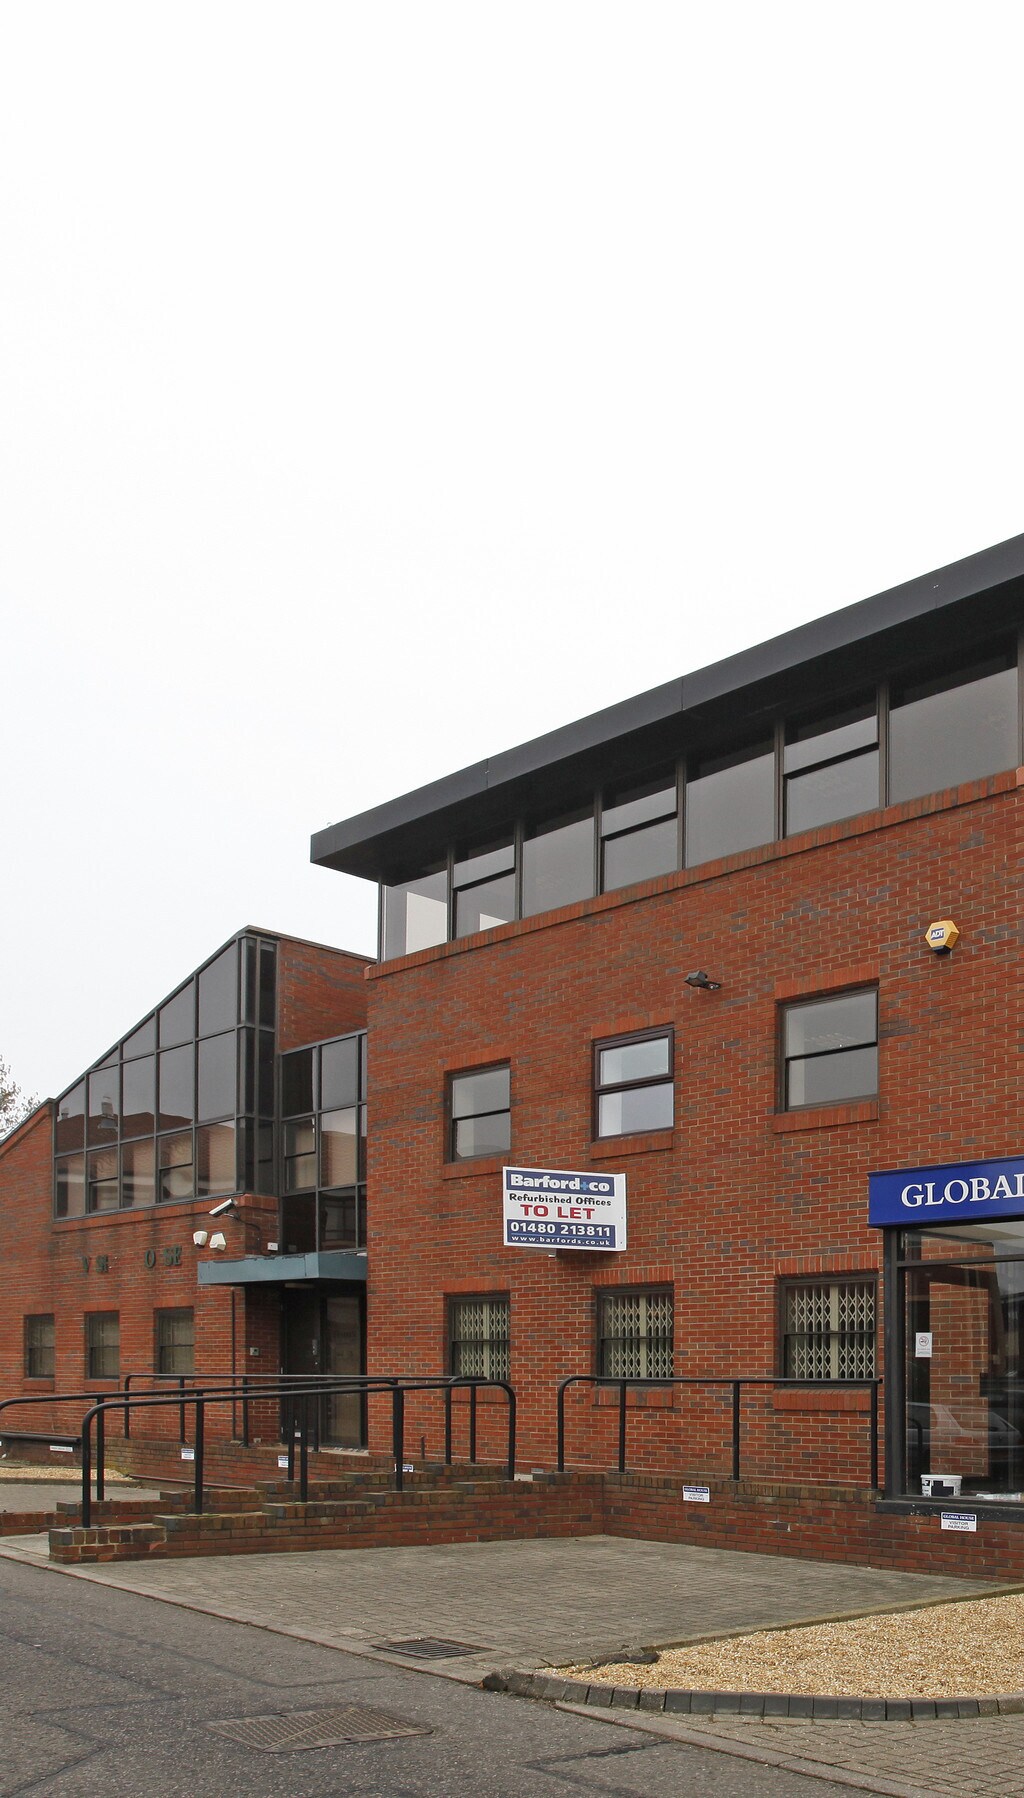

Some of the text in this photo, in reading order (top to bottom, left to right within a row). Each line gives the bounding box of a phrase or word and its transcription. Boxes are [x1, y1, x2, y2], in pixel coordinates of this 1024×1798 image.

[931, 929, 945, 939] ADT
[509, 1193, 612, 1206] Refurbished Offices
[520, 1204, 596, 1219] TO LET
[510, 1222, 611, 1237] 01480 213811
[511, 1235, 611, 1246] www.barfords.co.uk
